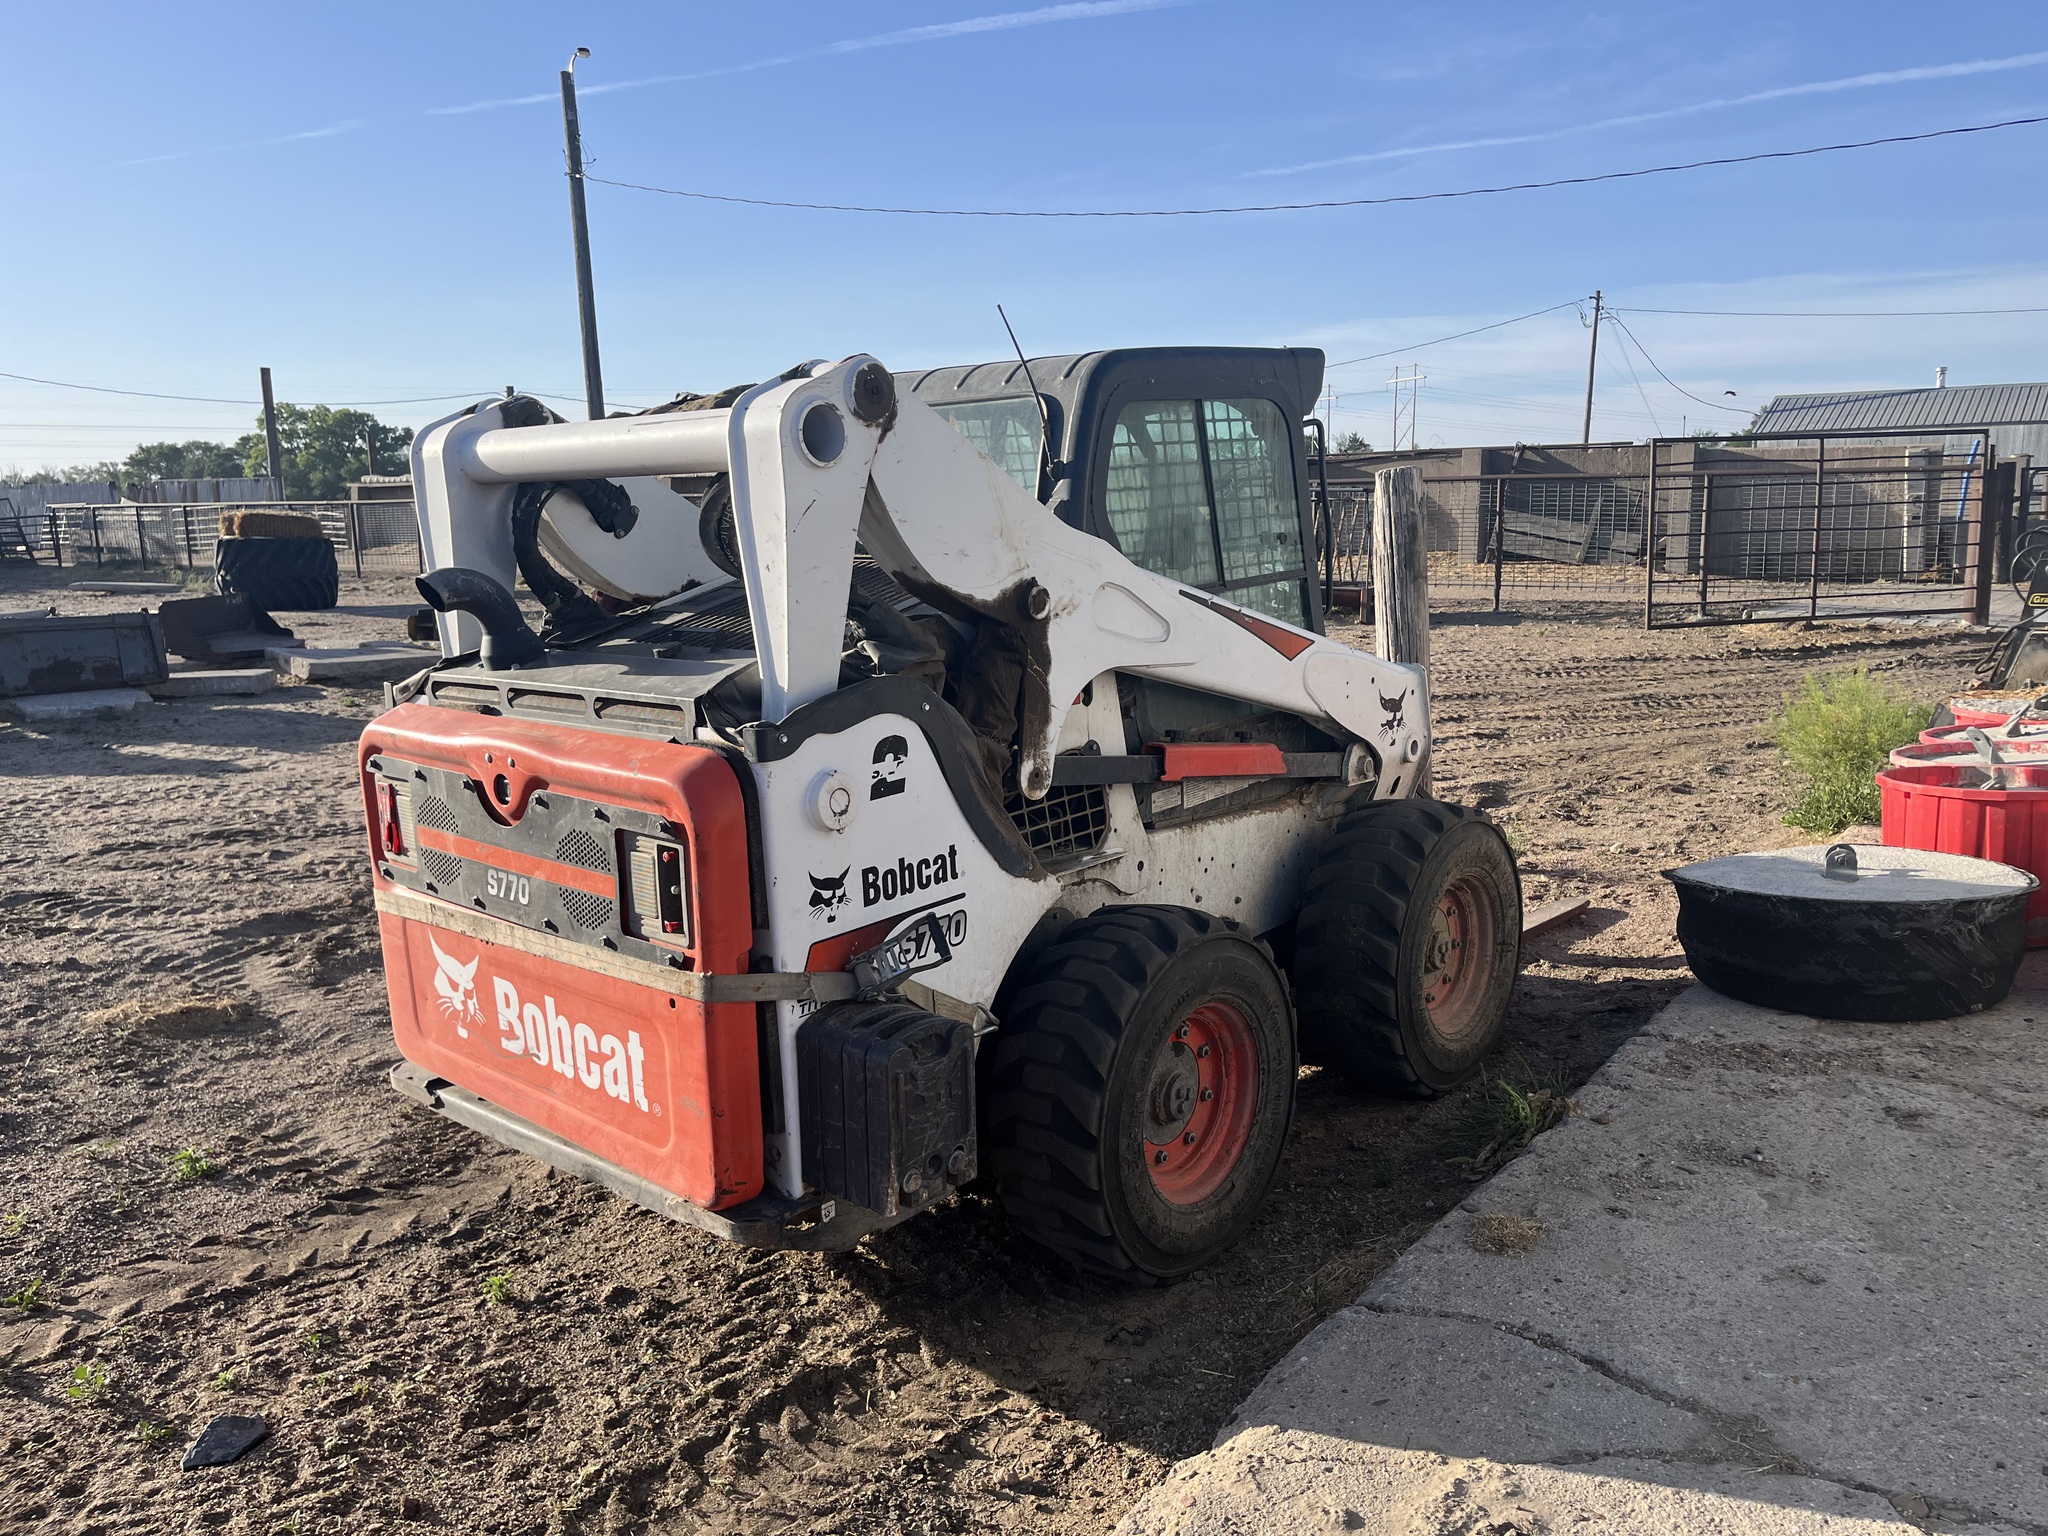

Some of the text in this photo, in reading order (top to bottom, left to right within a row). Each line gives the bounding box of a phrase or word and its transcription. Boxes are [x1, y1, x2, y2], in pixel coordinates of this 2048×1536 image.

[487, 868, 530, 905] S770
[861, 844, 959, 908] Bobcat
[493, 976, 649, 1112] Bobcat
